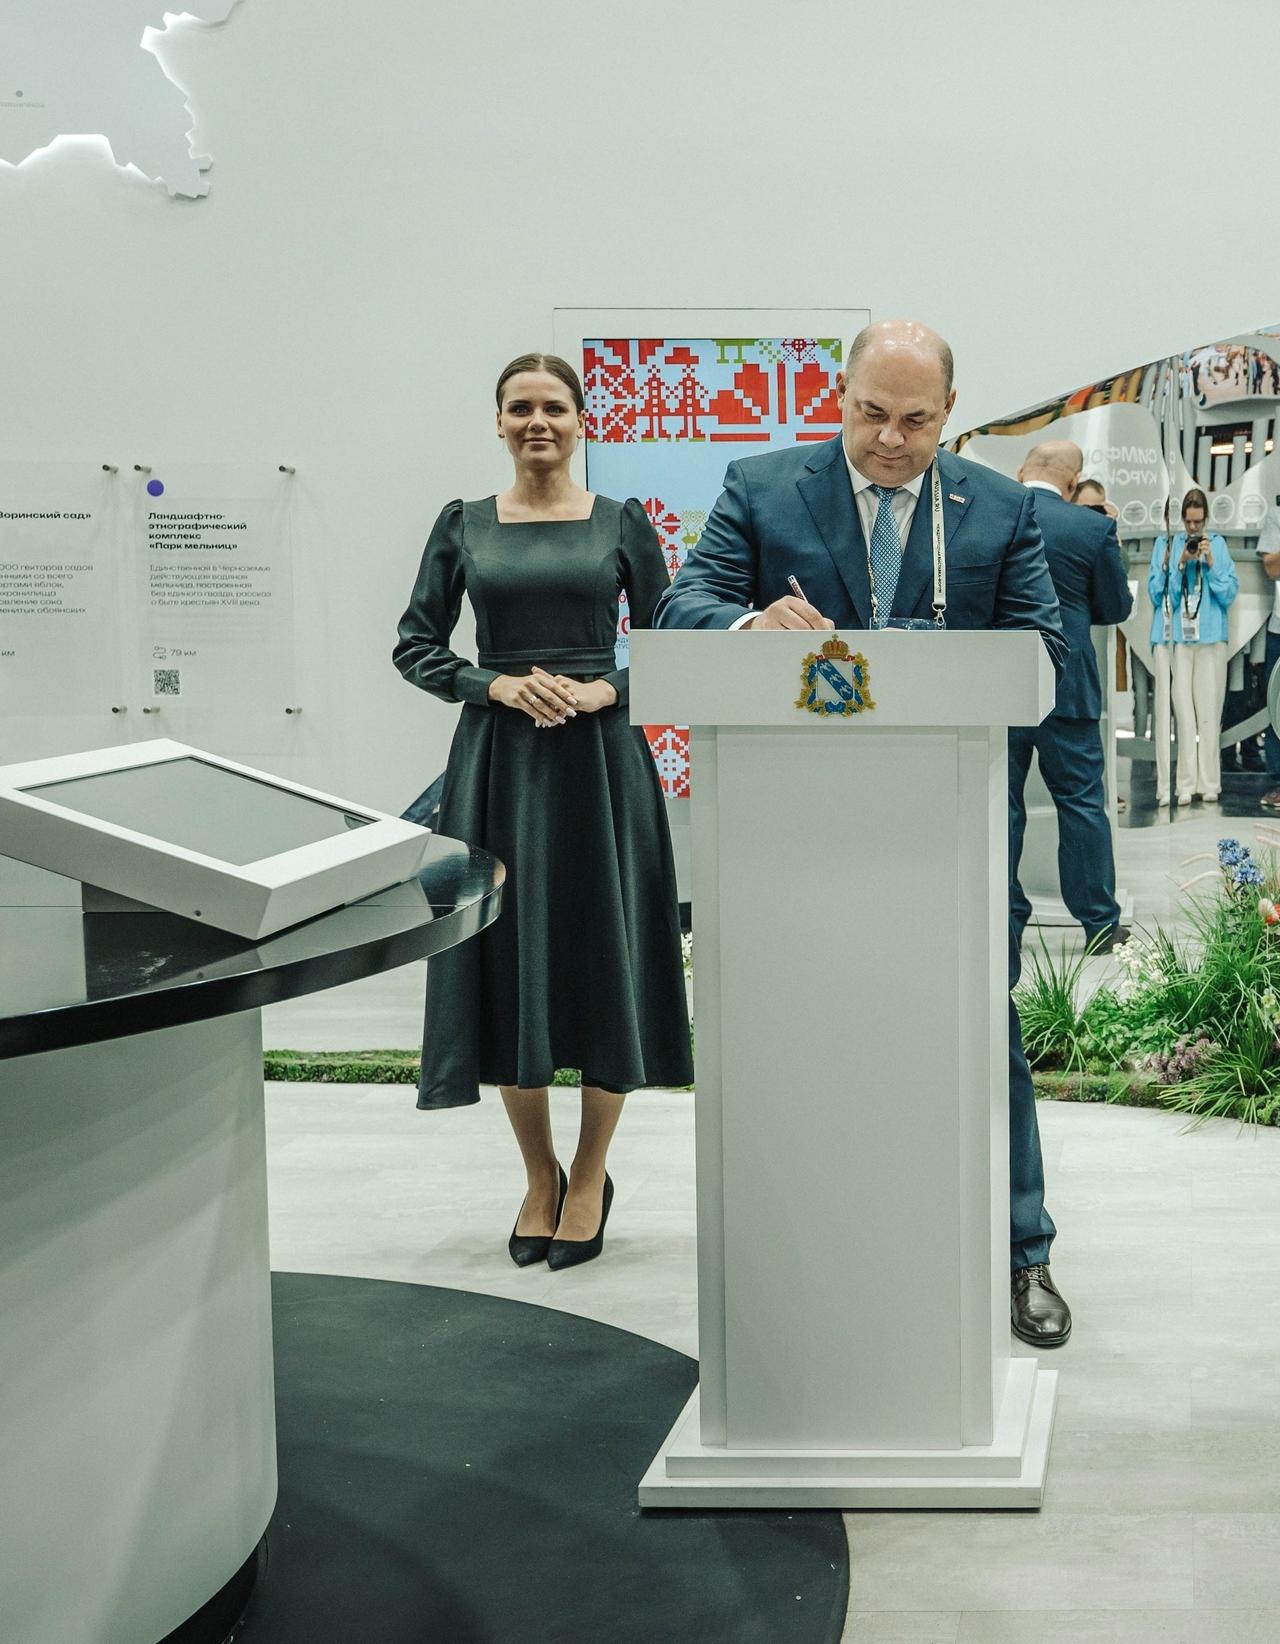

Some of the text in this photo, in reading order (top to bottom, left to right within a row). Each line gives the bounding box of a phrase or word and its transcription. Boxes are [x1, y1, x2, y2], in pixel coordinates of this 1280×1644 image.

[148, 512, 226, 520] Ландшафтно-
[148, 522, 247, 531] этнографический
[149, 542, 238, 551] «Парк мельниц»
